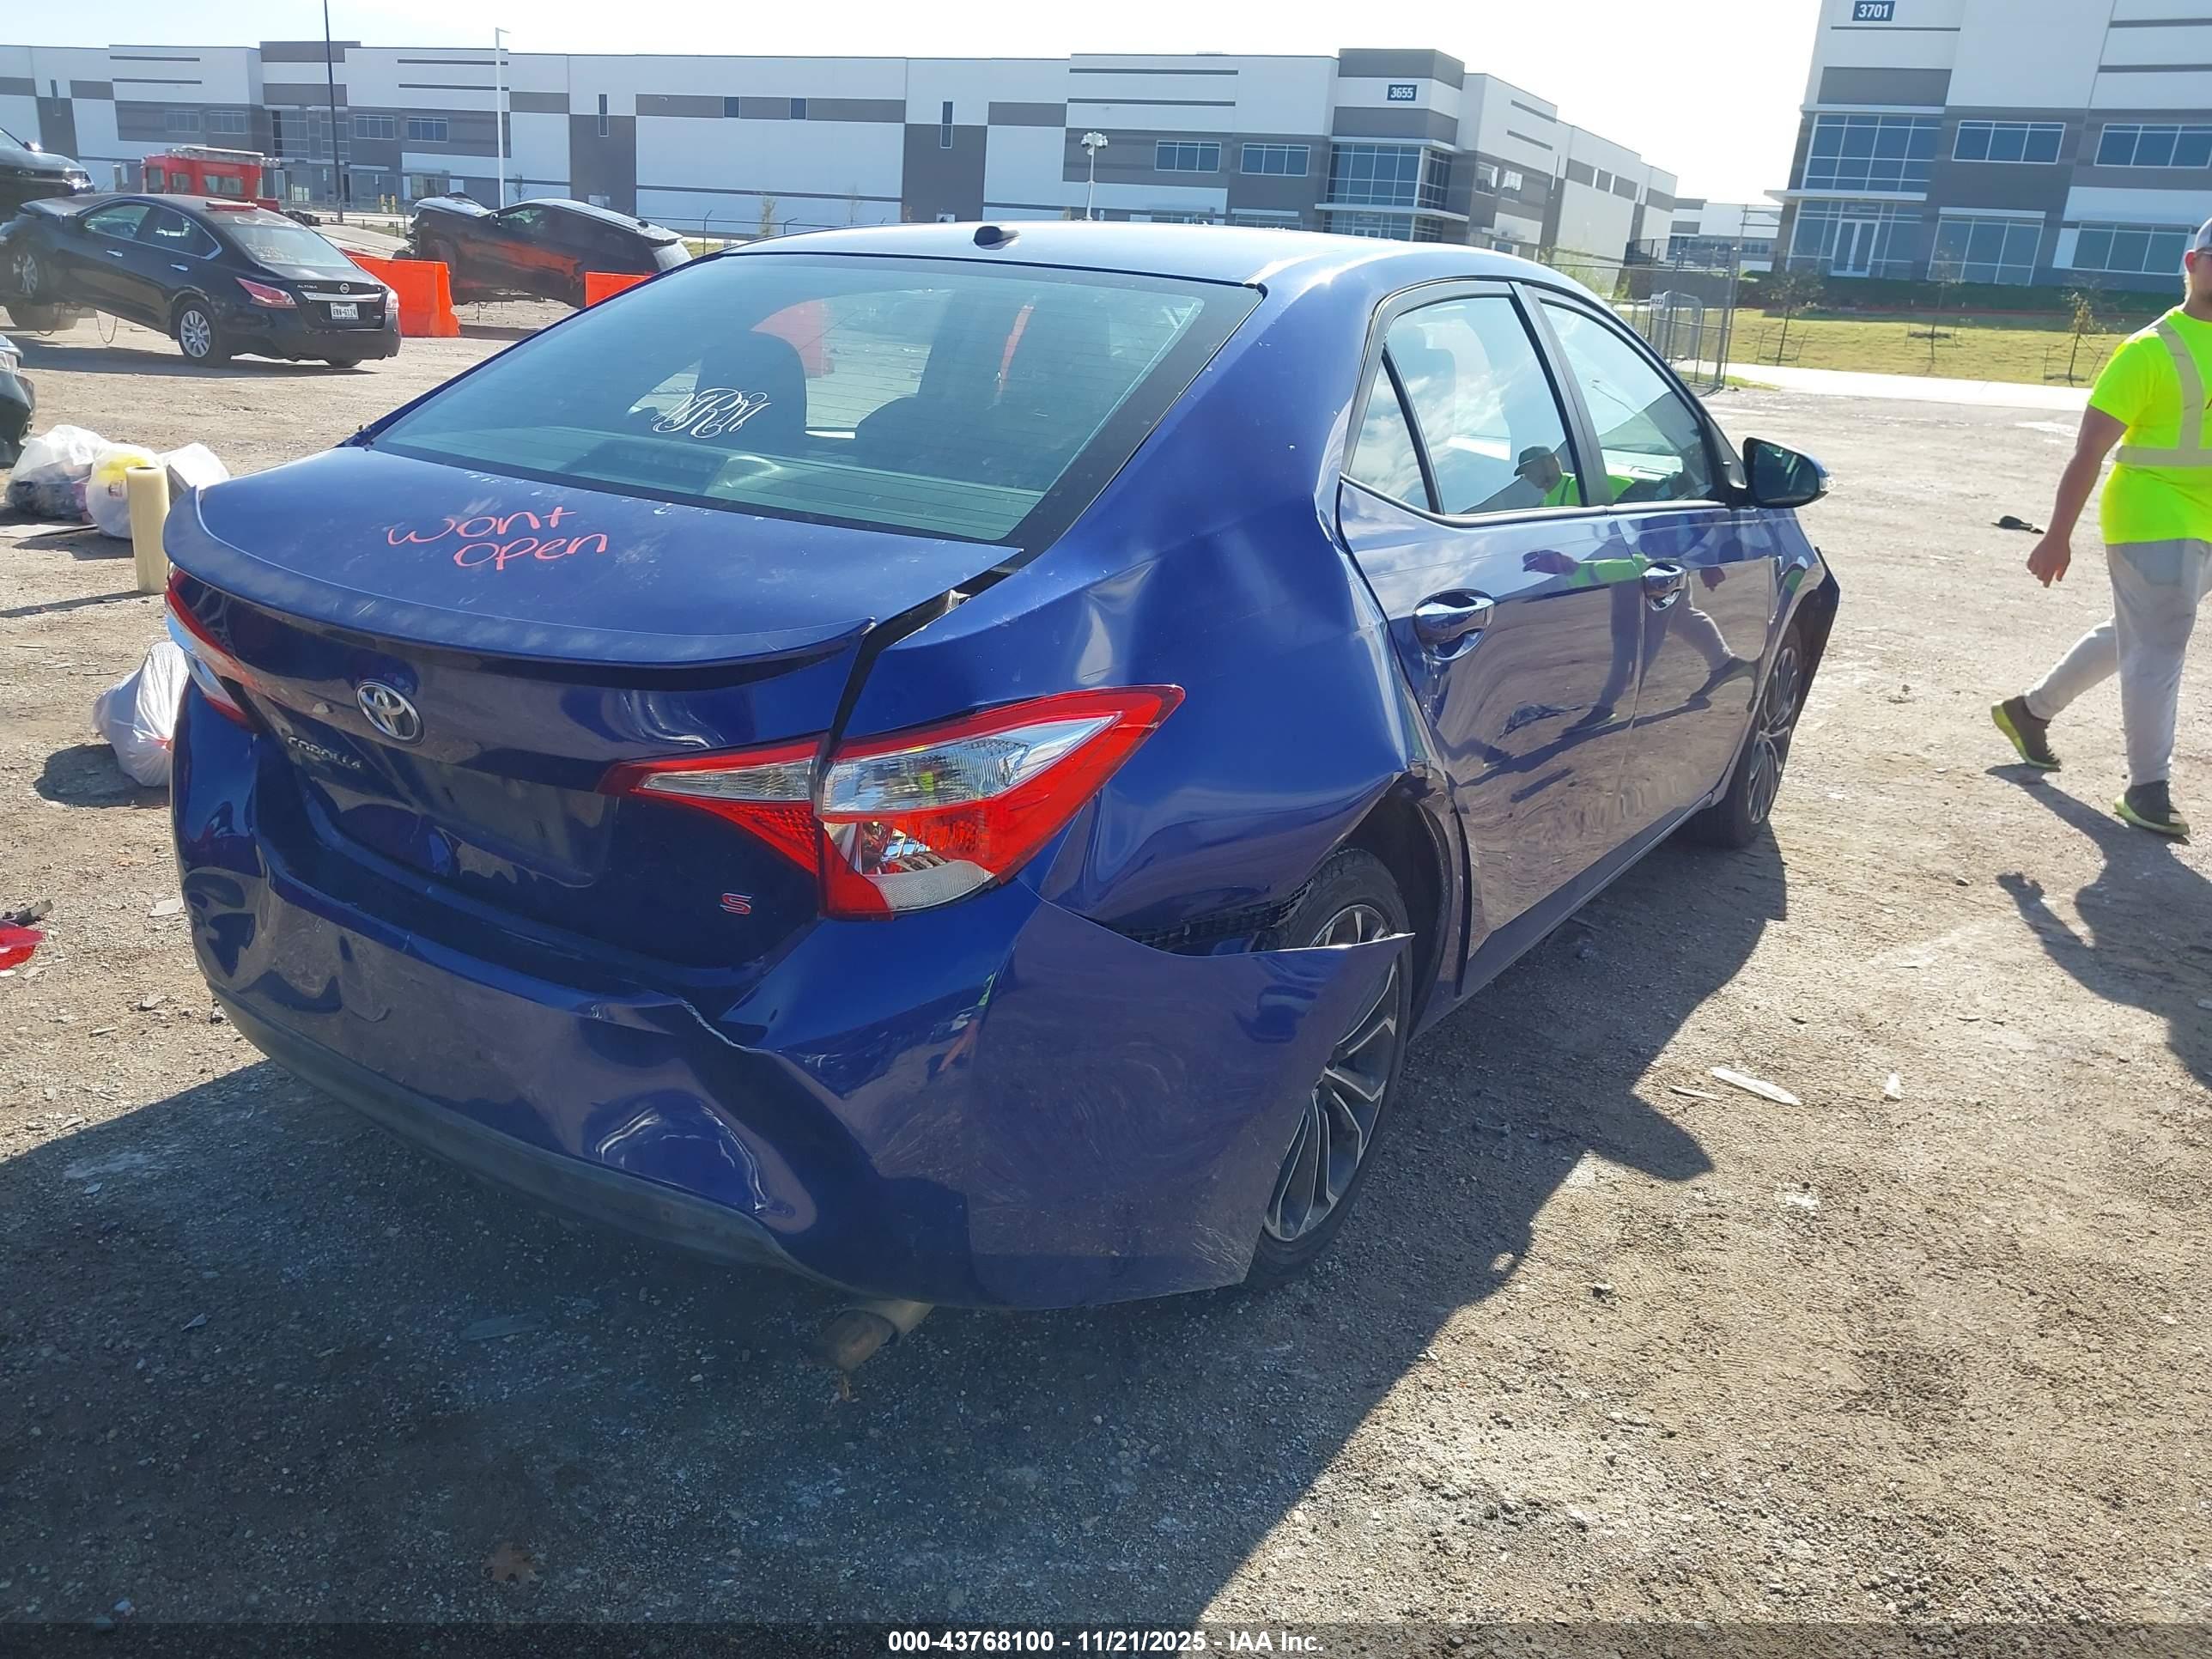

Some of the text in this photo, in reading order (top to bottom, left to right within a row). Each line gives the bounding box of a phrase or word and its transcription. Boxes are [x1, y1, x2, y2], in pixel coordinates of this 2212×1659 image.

[1858, 3, 1889, 18] 3701
[1390, 87, 1414, 99] 3655
[720, 892, 752, 915] S
